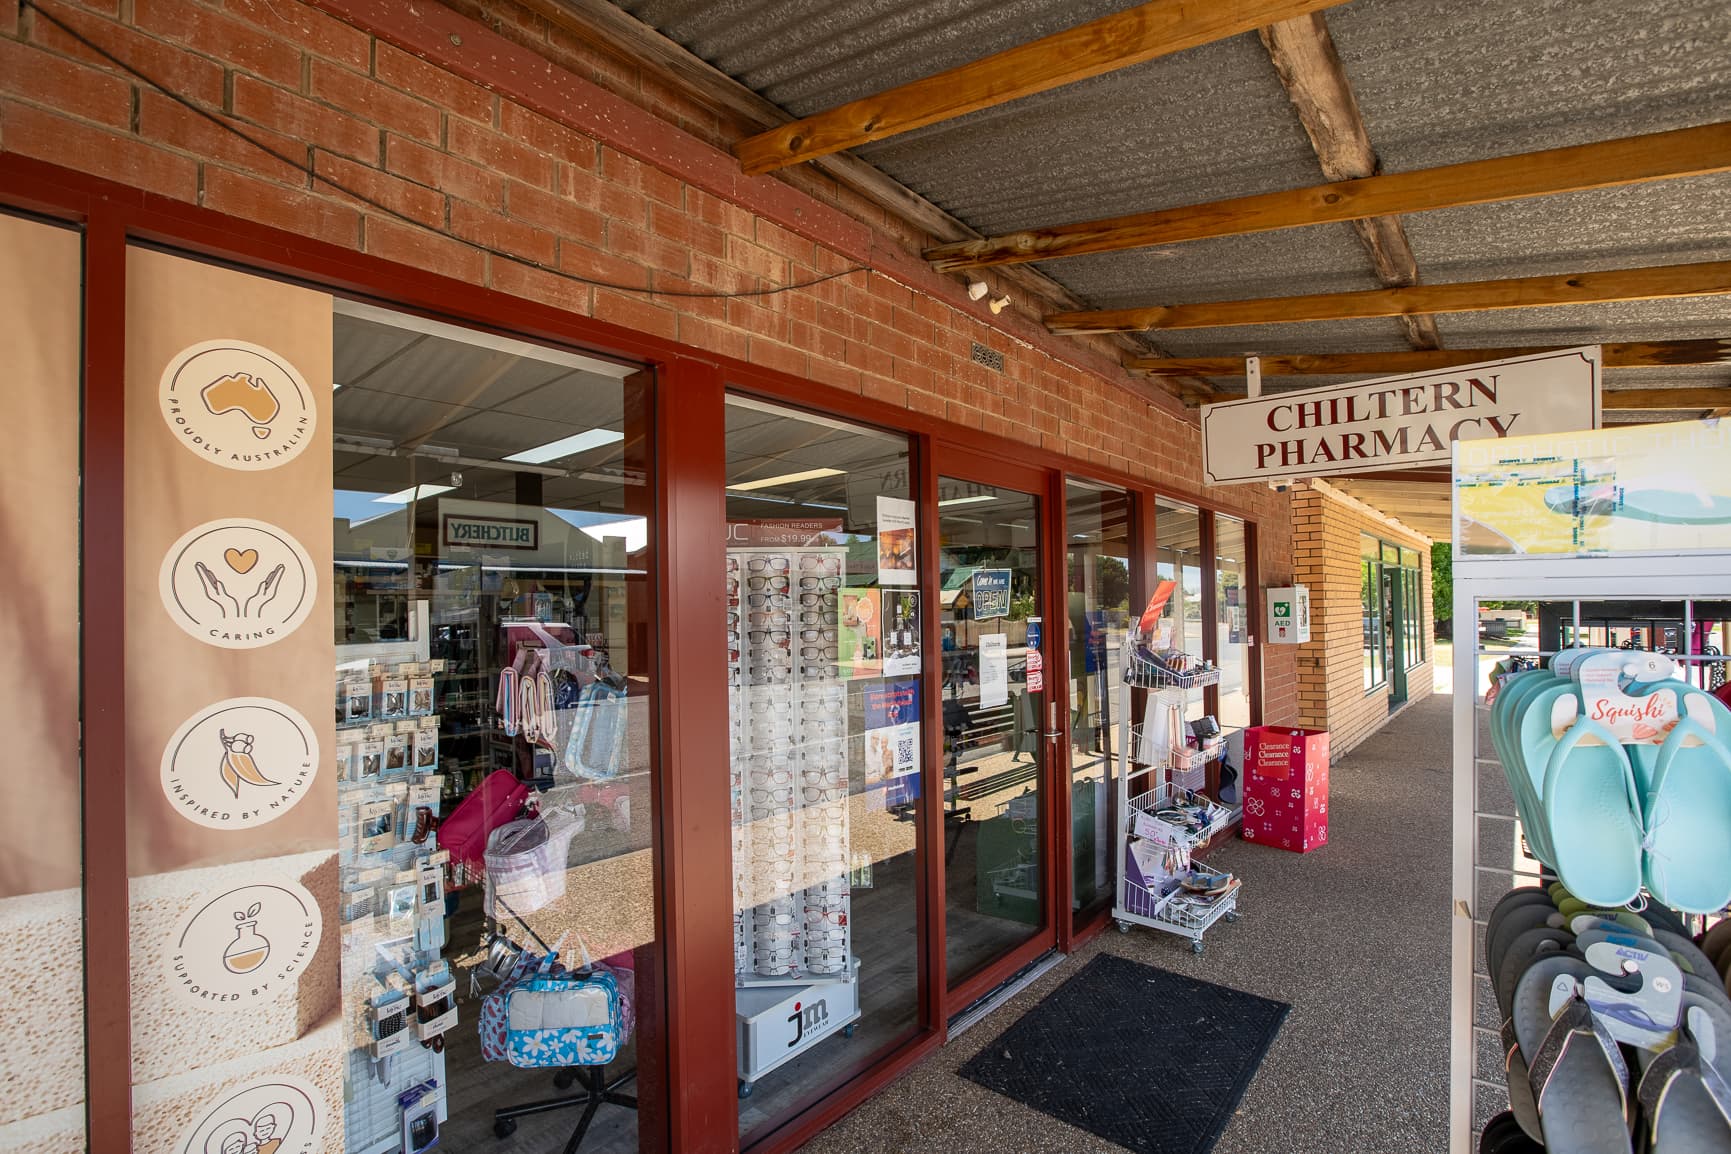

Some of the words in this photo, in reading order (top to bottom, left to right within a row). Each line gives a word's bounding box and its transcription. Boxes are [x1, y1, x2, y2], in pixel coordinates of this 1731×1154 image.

[1267, 375, 1500, 433] CHILTERN
[168, 398, 222, 456] PROUDLY
[230, 416, 308, 463] AUSTRALIAN
[1254, 413, 1520, 469] PHARMACY
[1648, 427, 1731, 449] THO
[781, 534, 811, 544] $19.99
[976, 590, 1007, 611] OPEN
[209, 626, 276, 642] CARING
[1648, 661, 1656, 670] 6
[1591, 692, 1665, 725] Squishi
[1259, 742, 1290, 750] Clearance
[1259, 750, 1289, 759] Clearance
[1258, 759, 1289, 767] Clearance
[170, 777, 231, 822] INSPIRED
[242, 808, 261, 821] BY
[269, 760, 312, 809] NATURE
[173, 954, 241, 1003] SUPPORTED
[251, 983, 270, 997] BY
[277, 919, 314, 982] SCIENCE
[1616, 948, 1648, 961] ACTIV
[787, 998, 829, 1049] jm
